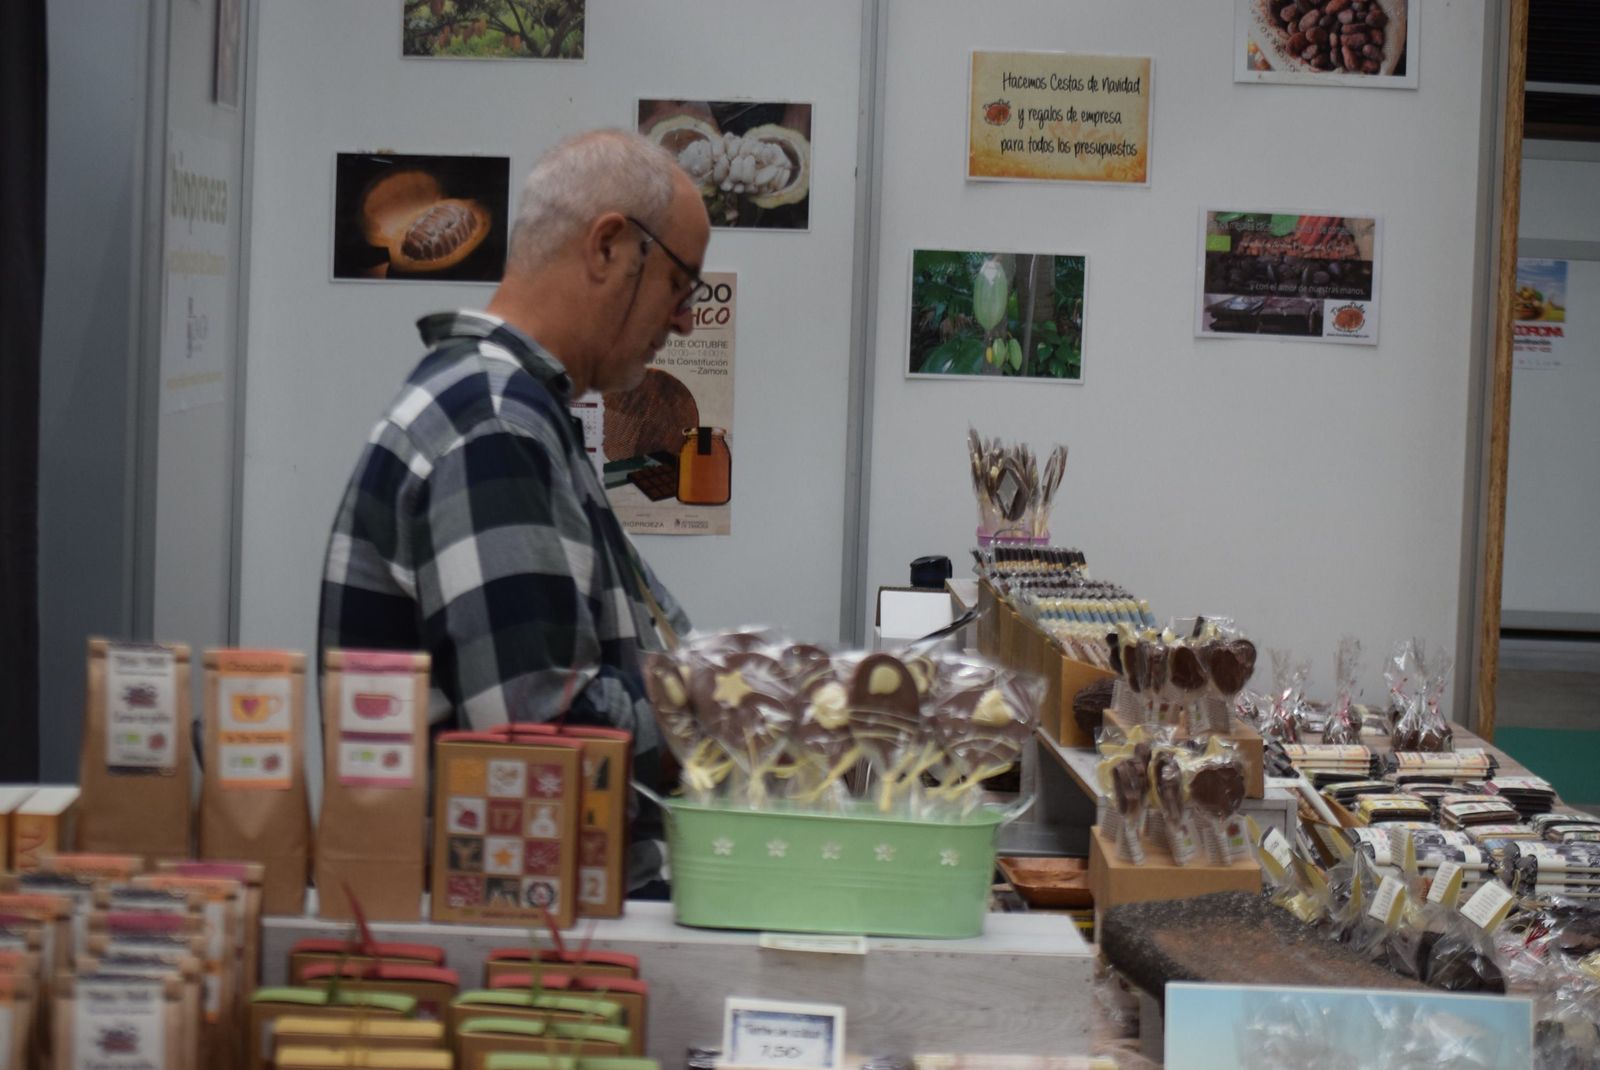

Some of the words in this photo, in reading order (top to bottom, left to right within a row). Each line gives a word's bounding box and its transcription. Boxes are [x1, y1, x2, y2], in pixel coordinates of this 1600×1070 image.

[1002, 72, 1047, 92] Hacemos
[1050, 73, 1084, 92] Cestas
[1087, 75, 1099, 93] de
[1102, 76, 1141, 95] Navidad
[1018, 110, 1025, 130] y
[1028, 105, 1063, 130] regalos
[1067, 106, 1078, 124] de
[1081, 111, 1122, 126] empresa
[1001, 138, 1025, 155] para
[1028, 136, 1055, 154] todos
[1058, 138, 1071, 154] los
[1074, 140, 1138, 159] presupuestos
[674, 340, 686, 348] DE
[687, 340, 728, 349] OCTUBRE
